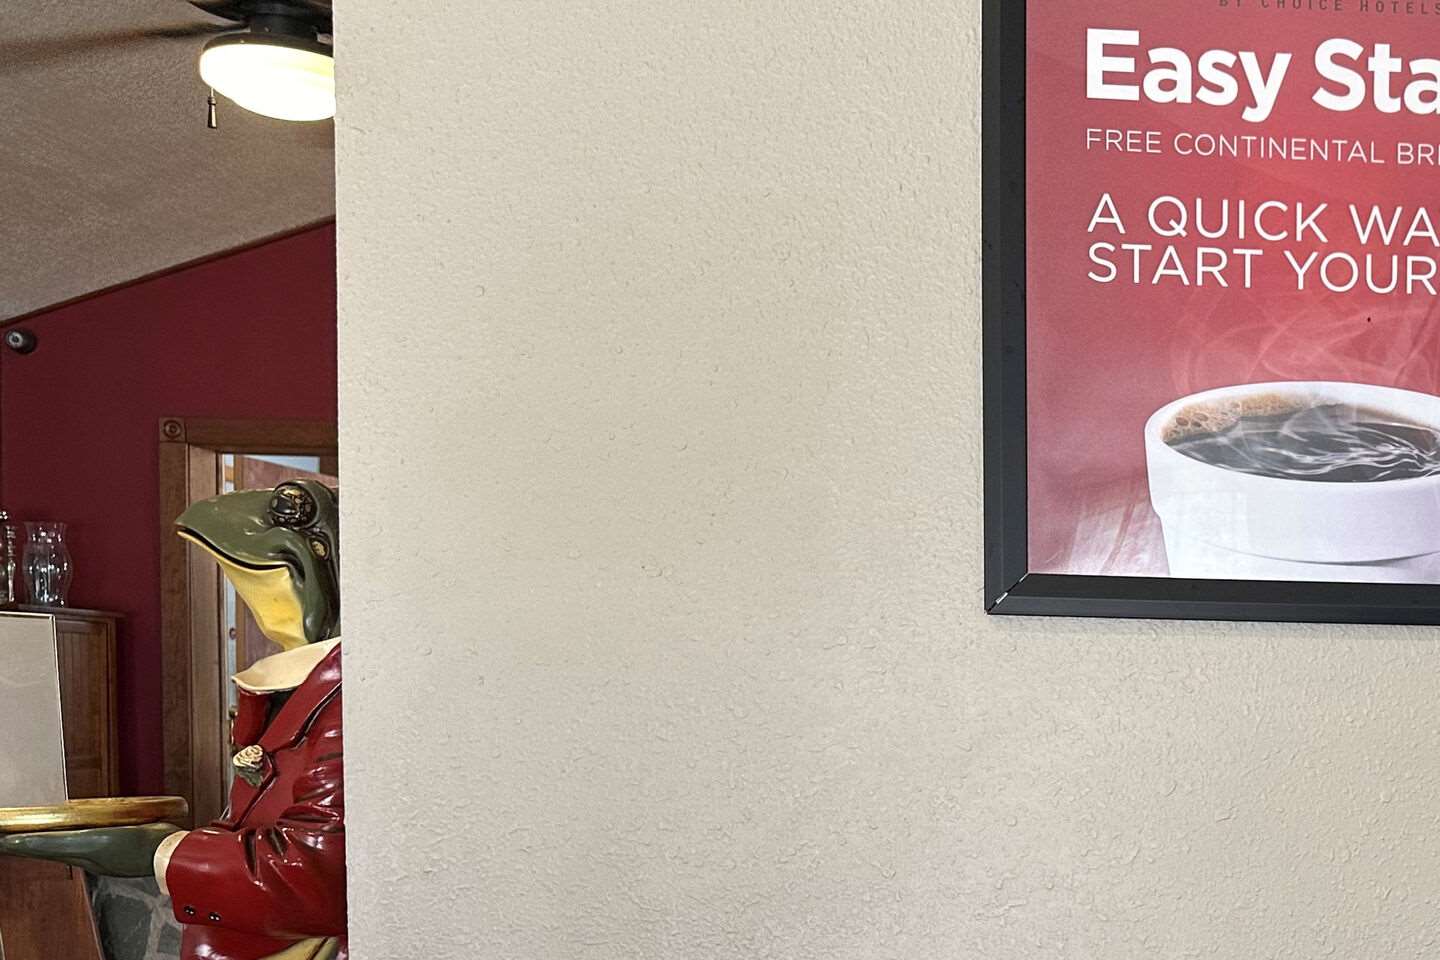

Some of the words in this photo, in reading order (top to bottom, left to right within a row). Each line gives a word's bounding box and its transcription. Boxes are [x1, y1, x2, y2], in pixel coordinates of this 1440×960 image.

[1261, 0, 1343, 11] CHOICE
[1086, 28, 1292, 122] Easy
[1087, 128, 1162, 153] FREE
[1174, 133, 1384, 163] CONTINENTAL
[1087, 193, 1126, 234] A
[1148, 195, 1328, 243] QUICK
[1088, 242, 1264, 288] START
[1283, 250, 1437, 295] YOUR
